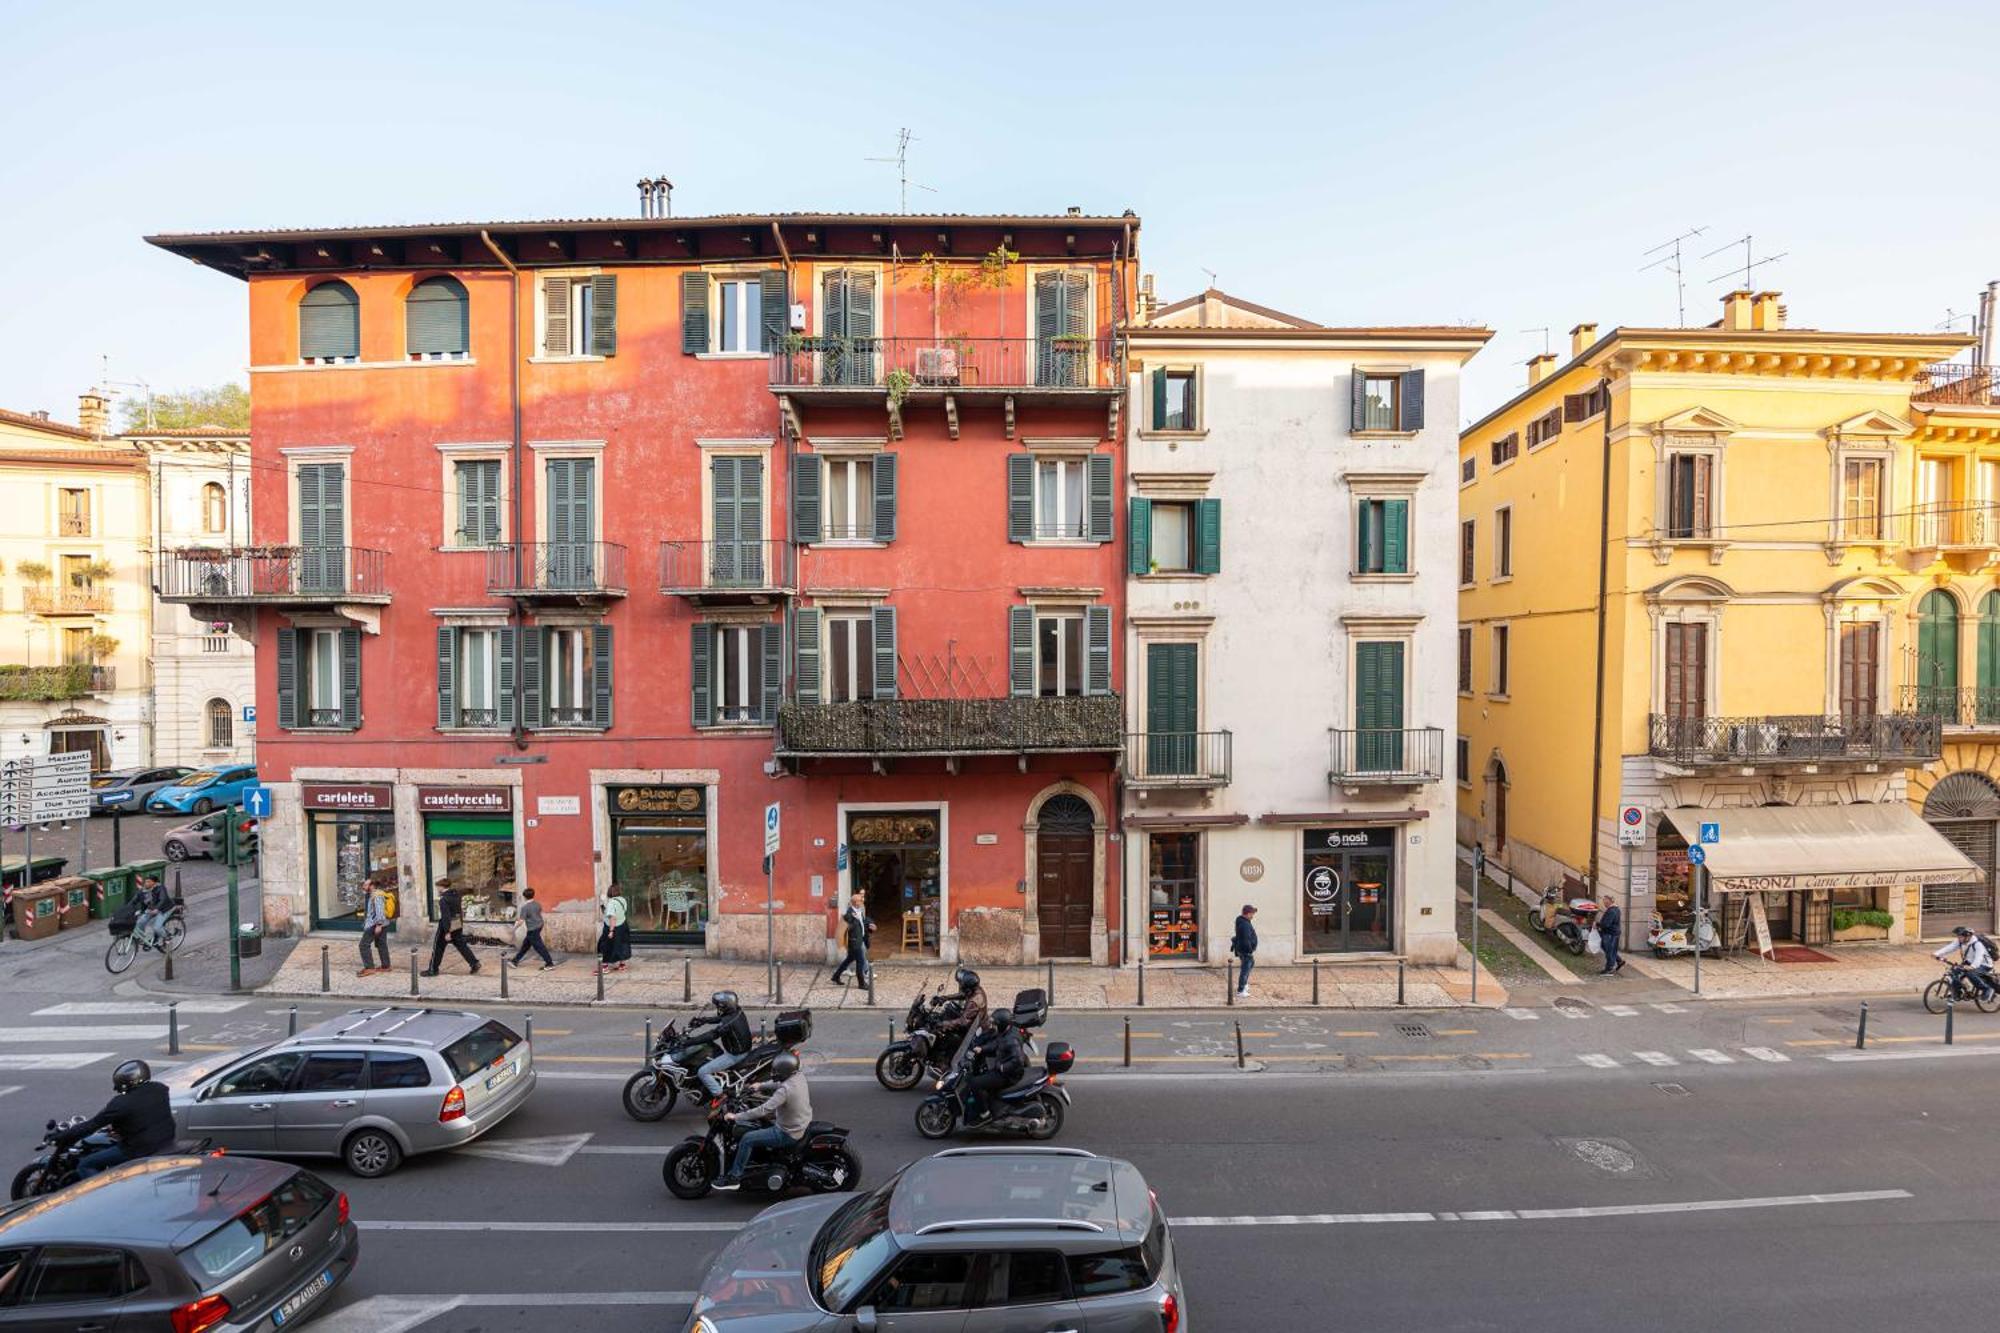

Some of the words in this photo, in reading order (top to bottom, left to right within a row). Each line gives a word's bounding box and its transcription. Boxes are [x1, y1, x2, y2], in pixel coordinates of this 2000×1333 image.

[36, 788, 88, 797] Accademia
[317, 791, 375, 803] cartoleria
[424, 794, 503, 805] castelvecchio
[1342, 831, 1369, 842] nosh
[1724, 876, 1797, 890] GARONZI
[1844, 875, 1861, 886] de
[1314, 889, 1332, 897] nosh
